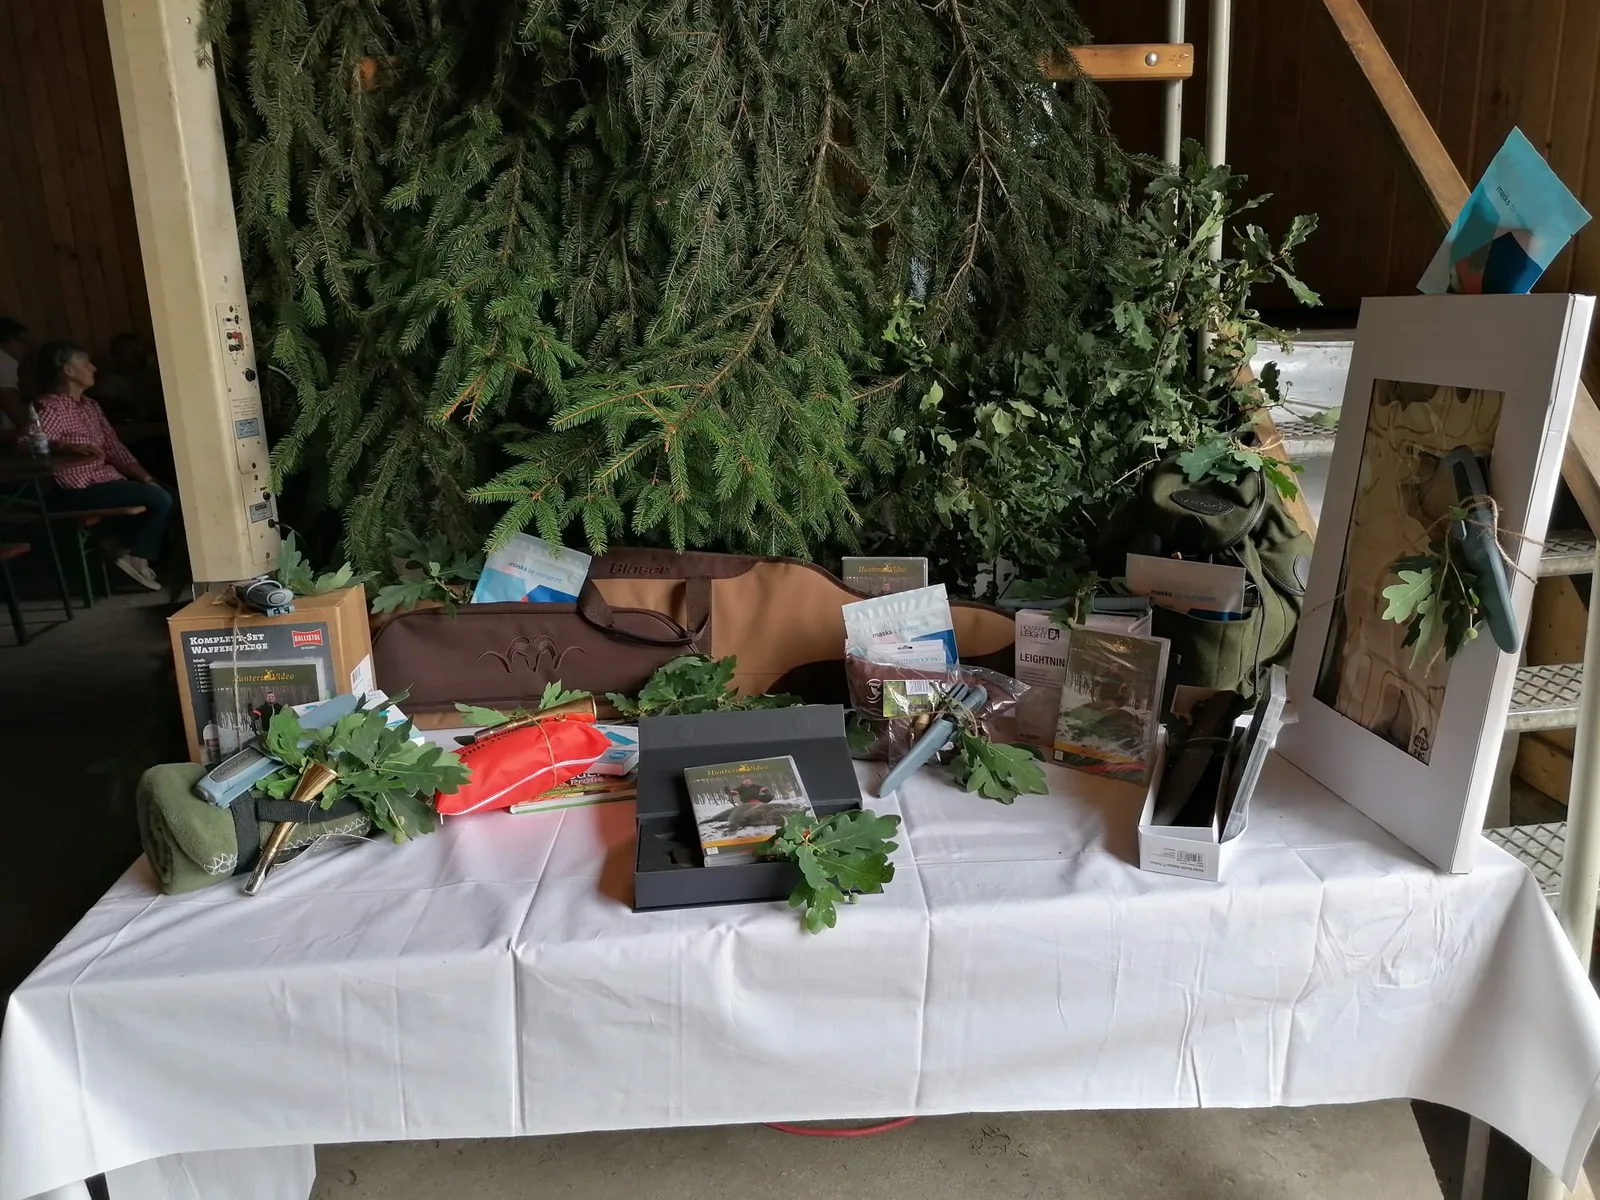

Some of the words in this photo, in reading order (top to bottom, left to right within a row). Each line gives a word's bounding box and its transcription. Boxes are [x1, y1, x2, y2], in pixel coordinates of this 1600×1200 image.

[1495, 185, 1511, 206] masks
[508, 561, 527, 572] masks
[609, 562, 671, 575] Blaser
[1150, 589, 1173, 597] masks
[294, 633, 321, 642] BALLISTOL
[872, 629, 893, 638] masks
[1020, 652, 1066, 668] LEIGHTNIN
